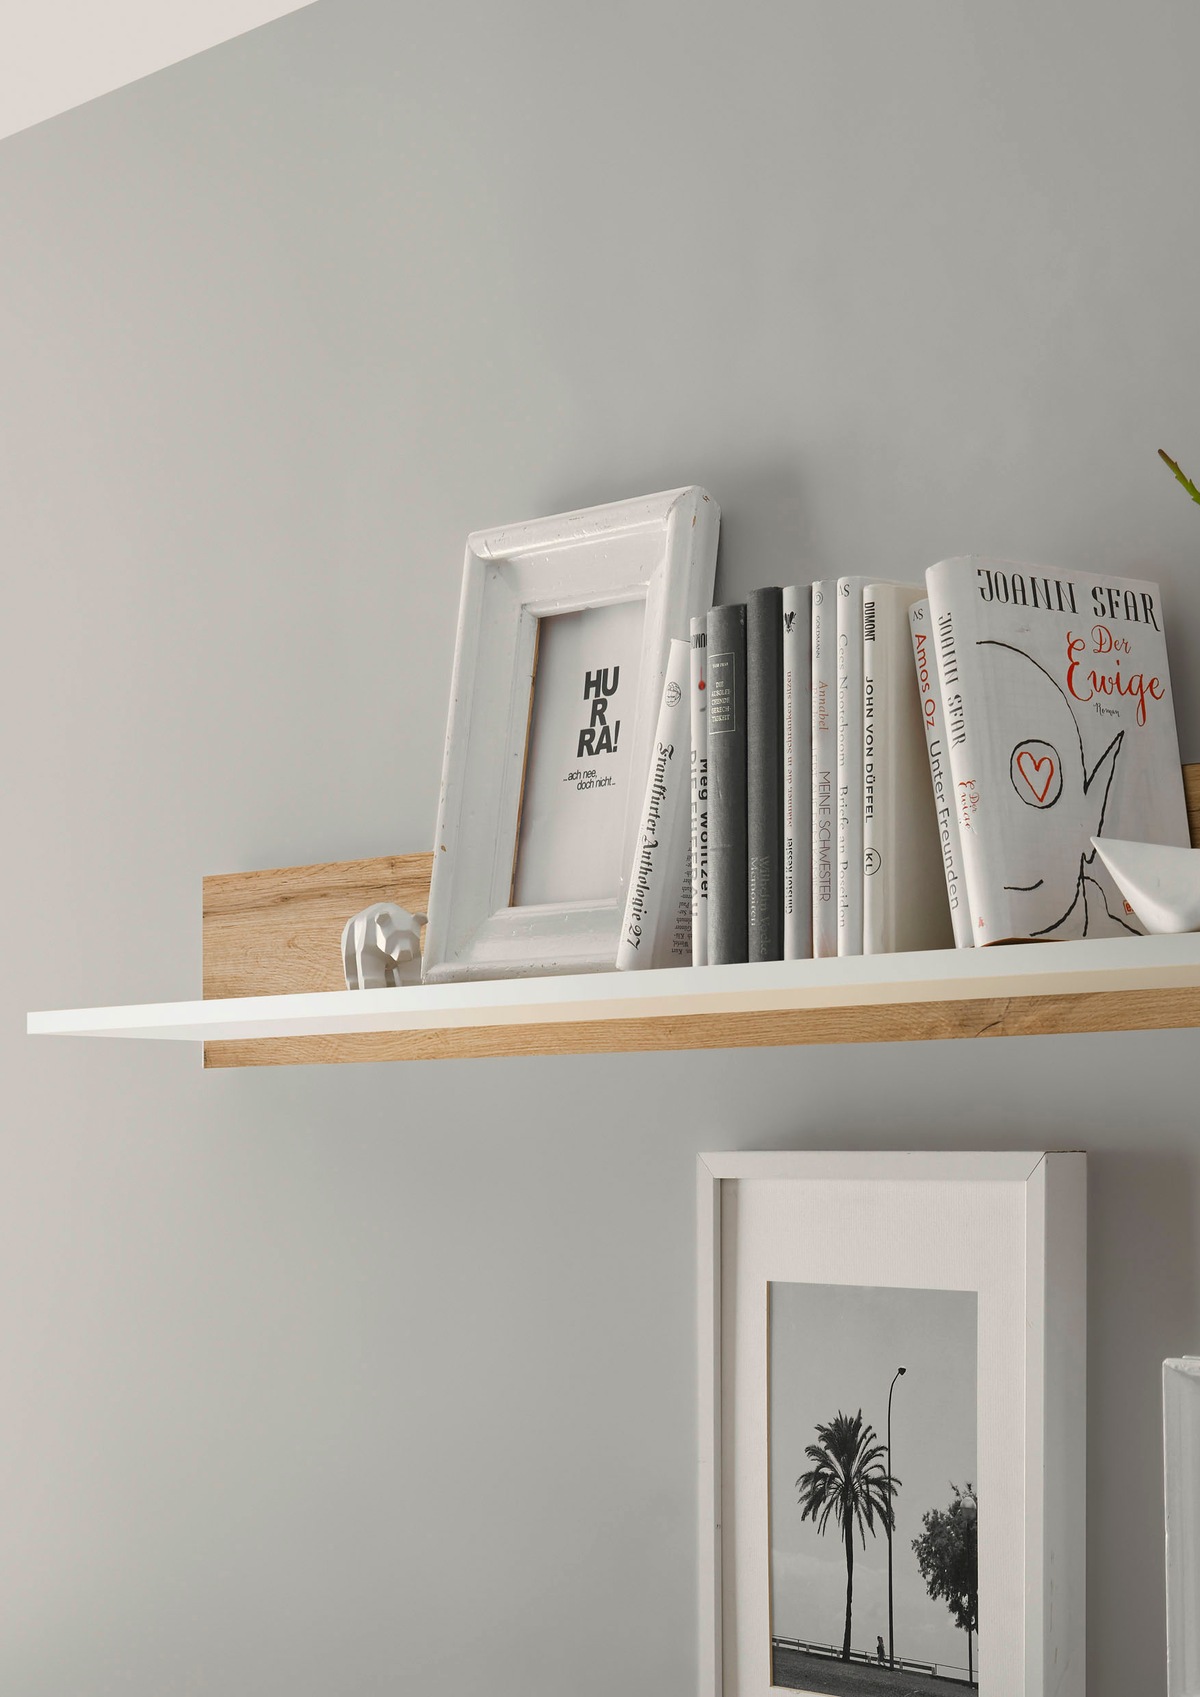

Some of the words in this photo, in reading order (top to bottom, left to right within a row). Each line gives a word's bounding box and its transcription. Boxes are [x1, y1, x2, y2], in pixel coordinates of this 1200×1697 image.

[865, 601, 875, 642] DUMONT
[977, 569, 1079, 614] JOANN
[1091, 586, 1161, 632] SFAR
[839, 633, 848, 670] Cees
[915, 633, 930, 693] Amos
[938, 612, 959, 686] JOANN
[1091, 625, 1131, 654] Der
[584, 666, 620, 700] HU
[866, 676, 874, 718] JOHN
[1066, 631, 1165, 727] Ewige
[589, 698, 608, 727] R
[818, 680, 829, 730] Annabel
[839, 676, 849, 767] Nooteboom
[924, 698, 936, 731] Oz
[947, 694, 967, 750] SFAR
[1093, 702, 1120, 717] Roman
[577, 720, 620, 757] RA!
[866, 724, 874, 757] VON
[577, 778, 594, 790] doch
[648, 742, 674, 834] Frankfurter
[818, 771, 830, 815] MEINE
[866, 763, 875, 823] DÜFFEL
[929, 740, 945, 803] Unter
[839, 786, 849, 834] Briefe
[818, 820, 831, 901] SCHWESTER
[839, 836, 845, 854] an
[866, 853, 873, 871] KL
[939, 807, 959, 911] Freunden
[632, 834, 659, 922] Anthologie
[750, 857, 758, 926] Memoiren
[760, 856, 770, 911] Wilhelm
[839, 861, 849, 928] Poseidon
[627, 924, 642, 949] 27
